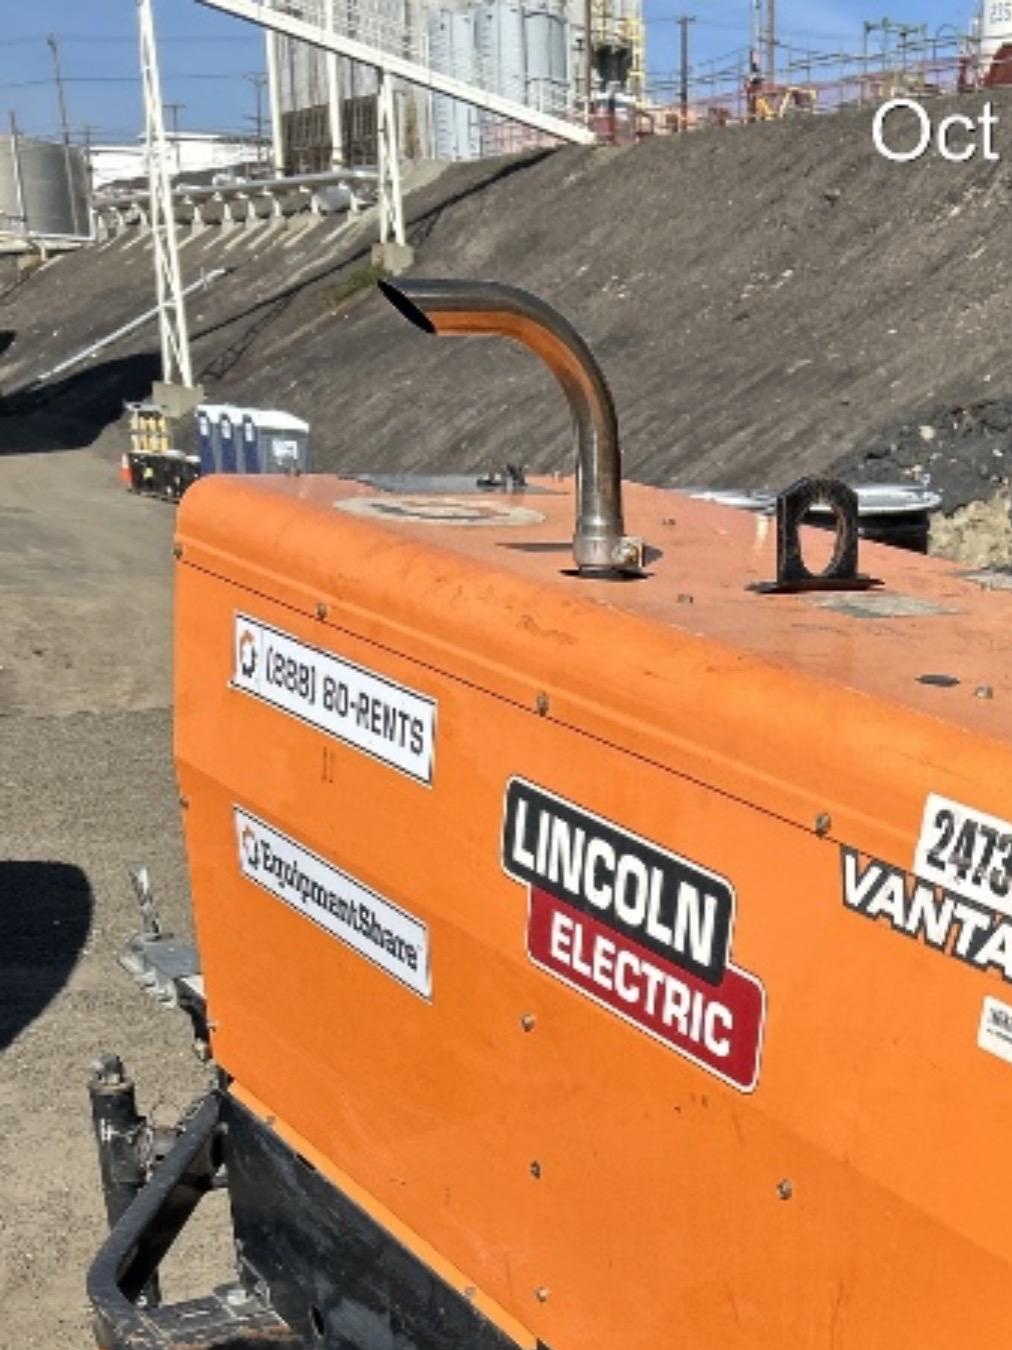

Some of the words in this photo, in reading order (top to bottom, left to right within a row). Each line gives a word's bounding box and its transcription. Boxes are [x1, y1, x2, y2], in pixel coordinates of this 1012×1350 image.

[265, 645, 316, 706] (888)
[322, 675, 425, 757] 80-RENTS
[258, 839, 420, 972] EquipmentShare
[511, 798, 718, 967] LINCOLN
[550, 910, 733, 1058] ELECTRIC
